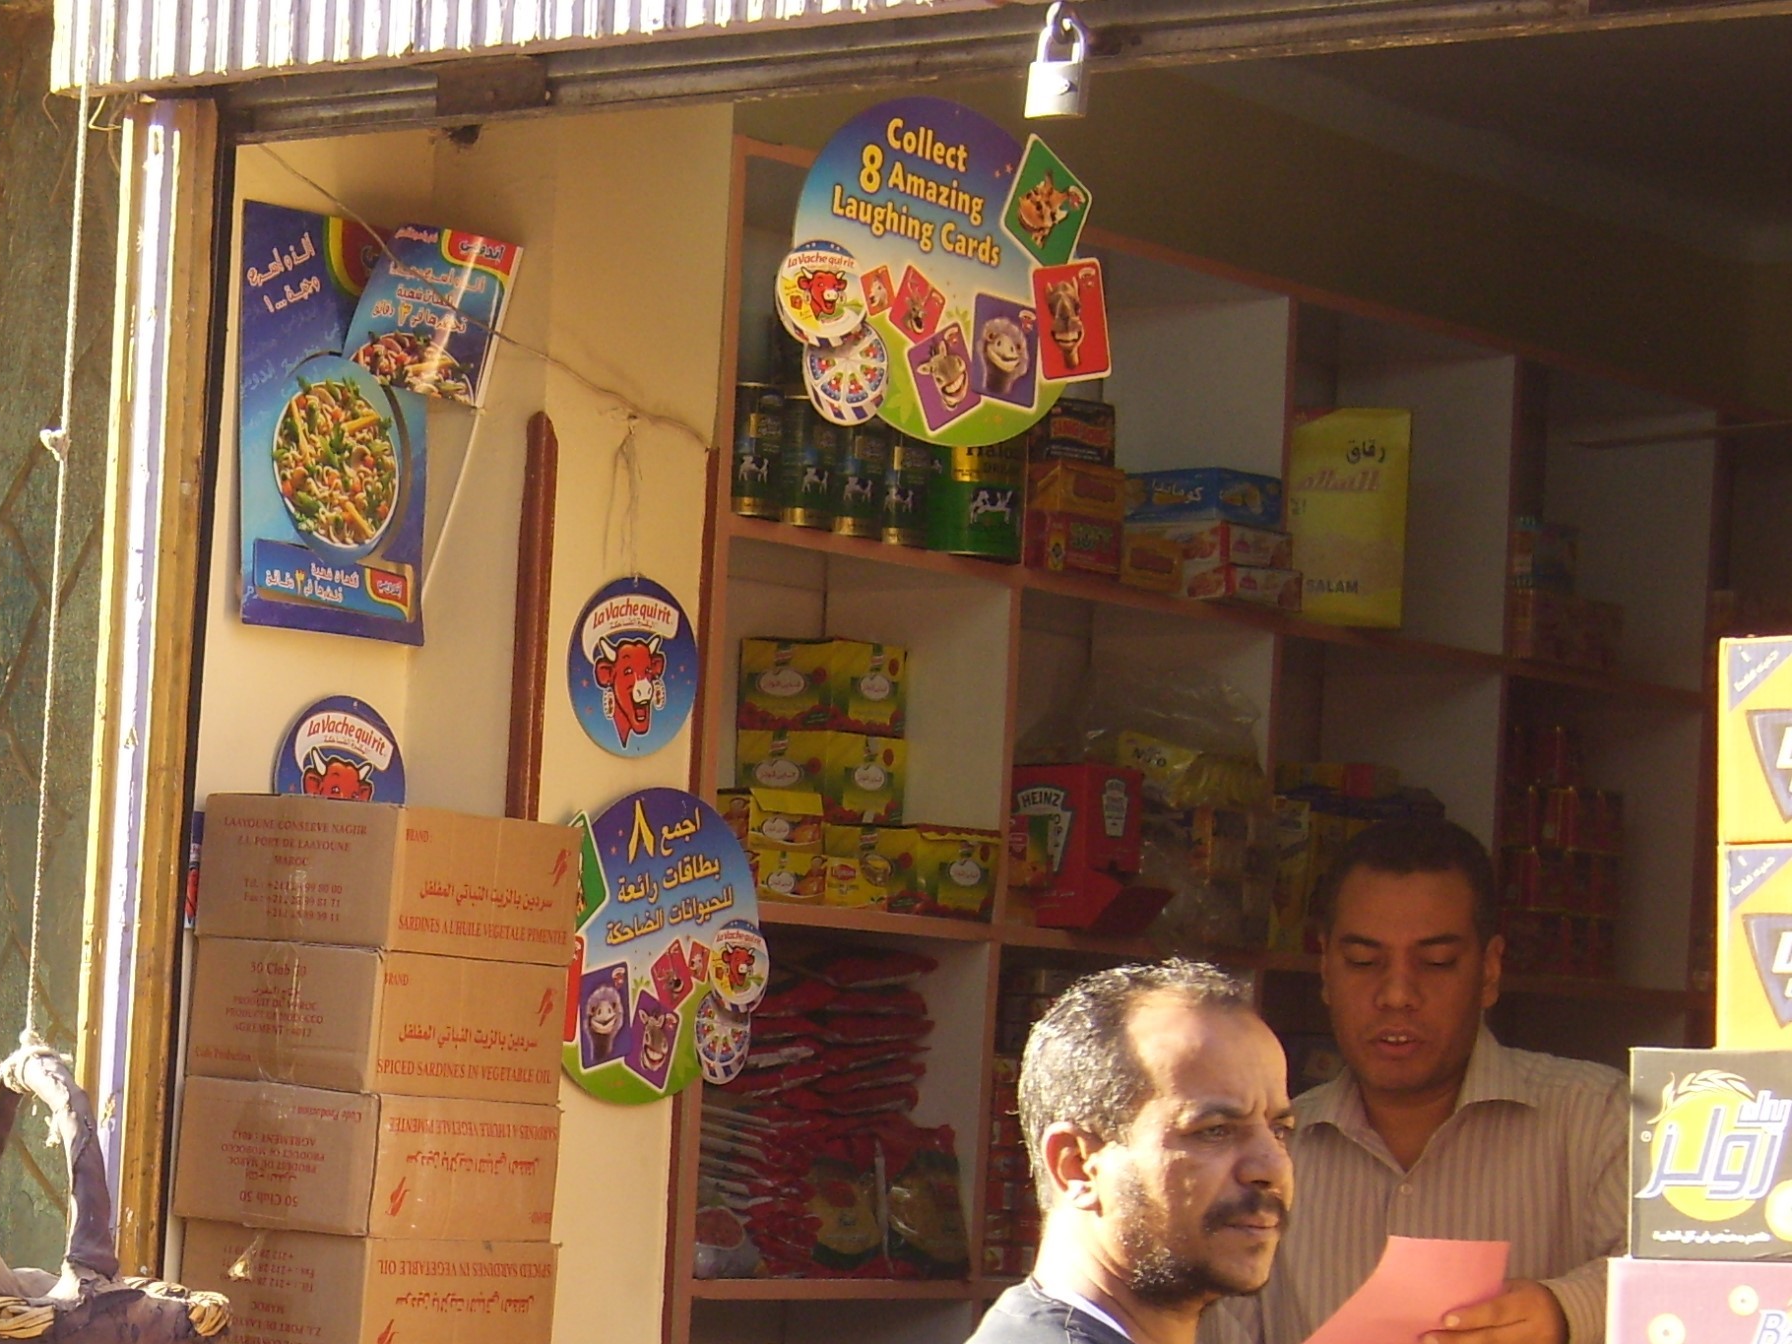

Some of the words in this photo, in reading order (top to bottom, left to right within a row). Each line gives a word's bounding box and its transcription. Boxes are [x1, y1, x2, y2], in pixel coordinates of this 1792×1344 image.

[887, 118, 968, 172] Collect
[859, 144, 884, 194] 8
[888, 165, 985, 227] Amazing
[832, 185, 934, 253] Laughing
[940, 222, 1001, 269] Cards
[593, 612, 605, 629] La
[605, 598, 639, 621] Vache
[640, 603, 658, 621] qui
[658, 606, 672, 624] rit
[307, 720, 321, 737] La
[321, 715, 355, 737] Vache
[355, 728, 374, 743] qui
[371, 737, 385, 756] rit
[1020, 790, 1062, 809] HEINZ
[628, 800, 656, 865] ٨
[660, 805, 703, 858] اجمع
[663, 855, 721, 890] بطاقات
[617, 873, 658, 905] رائعة
[669, 885, 734, 926] للحيوانات
[605, 907, 665, 947] الضاحكة
[474, 1029, 506, 1051] بالزيت
[507, 1033, 538, 1052] سردين
[377, 1058, 415, 1076] SPICED
[418, 1062, 466, 1079] SARDINES
[469, 1065, 482, 1080] IN
[482, 1066, 534, 1084] VEGETABLE
[536, 1070, 552, 1084] OIL
[377, 1259, 397, 1276] OIL
[399, 1260, 458, 1277] VEGETABLE
[460, 1262, 471, 1277] IN
[473, 1262, 519, 1279] SARDINES
